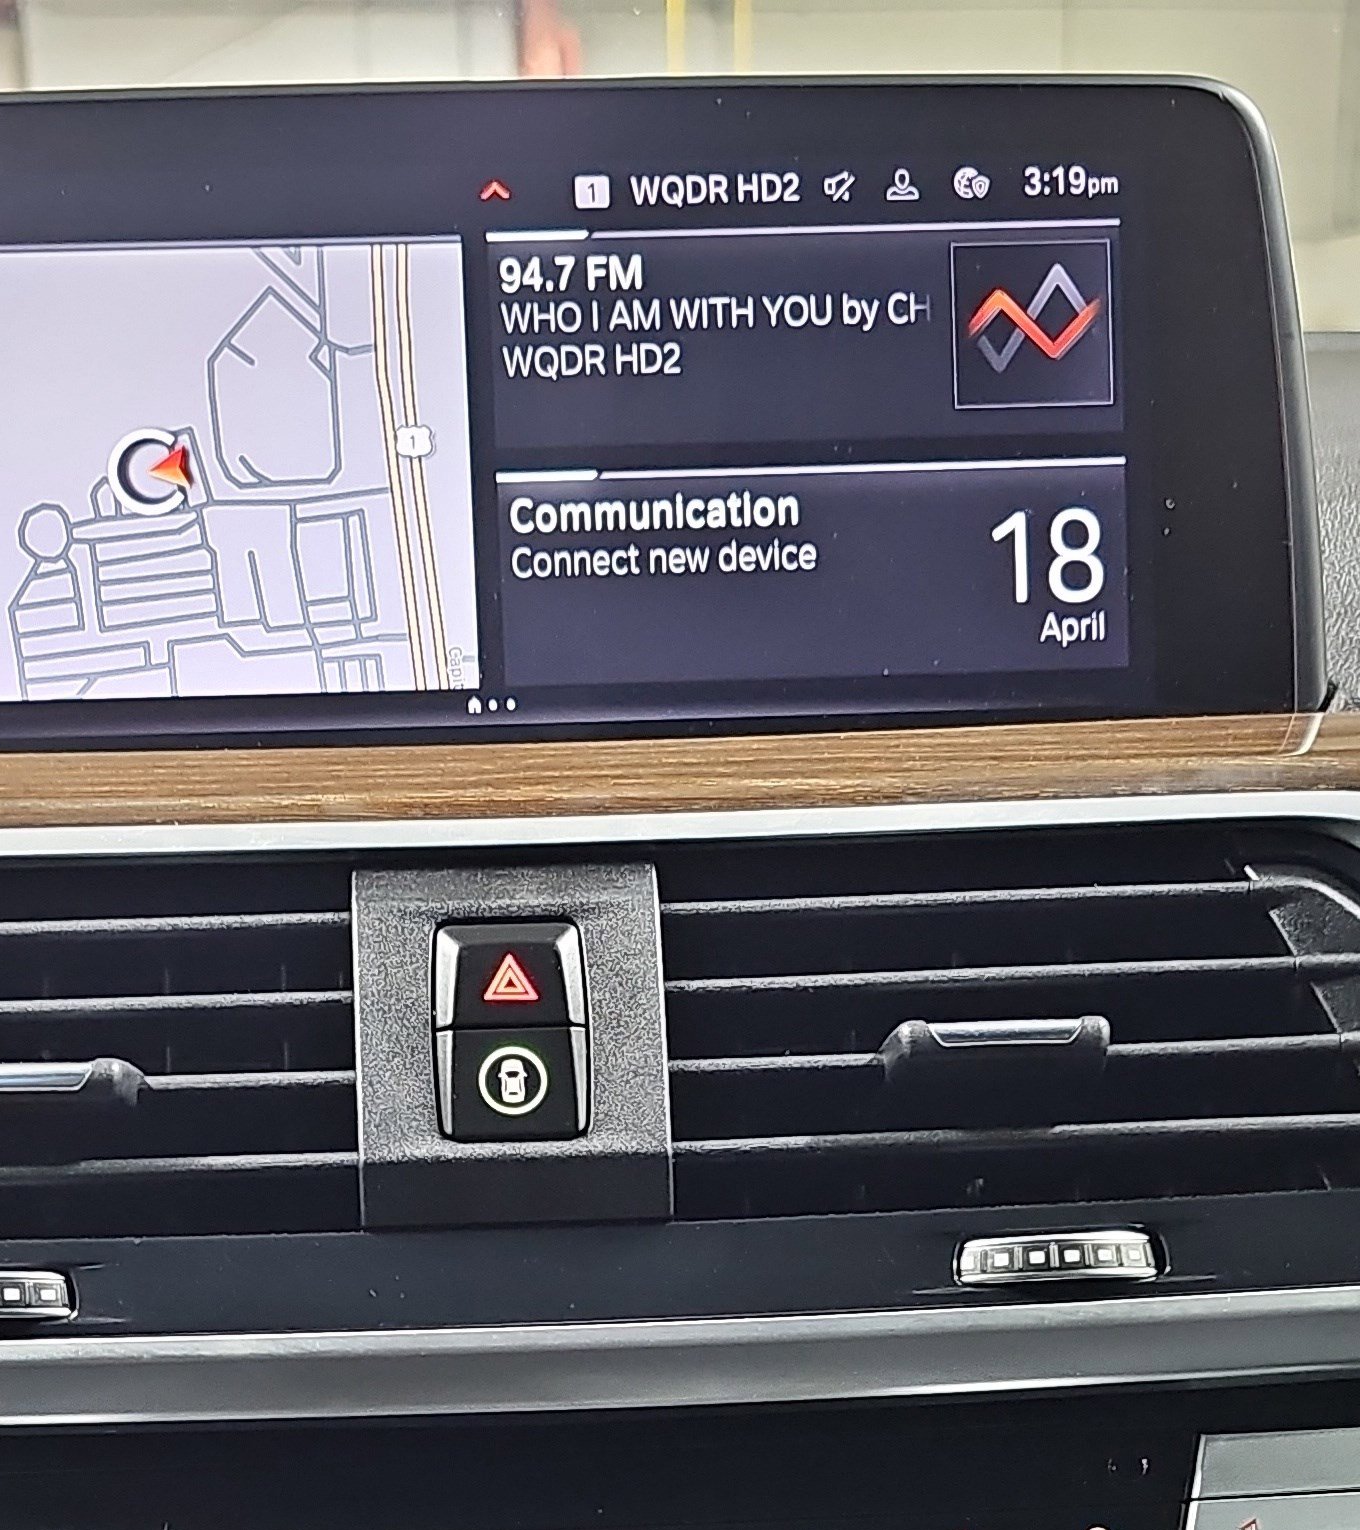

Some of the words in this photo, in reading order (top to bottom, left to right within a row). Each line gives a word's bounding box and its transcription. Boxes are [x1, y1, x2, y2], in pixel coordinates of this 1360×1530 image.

[587, 183, 596, 203] 1
[630, 173, 729, 208] WQDR
[737, 172, 801, 203] HD2
[1024, 164, 1119, 199] 3:19pm
[499, 255, 575, 294] 94.7
[587, 254, 642, 291] FM
[501, 301, 582, 334] WHO
[592, 300, 598, 332] I
[609, 298, 661, 331] AM
[669, 295, 754, 330] WITH
[762, 294, 832, 328] YOU
[842, 292, 880, 332] by
[502, 344, 606, 381] WQDR
[615, 342, 682, 376] HD2
[510, 490, 799, 534] Communication
[512, 543, 640, 579] Connect
[649, 546, 710, 574] new
[718, 538, 817, 573] device
[992, 507, 1104, 604] 18
[1040, 610, 1105, 648] April
